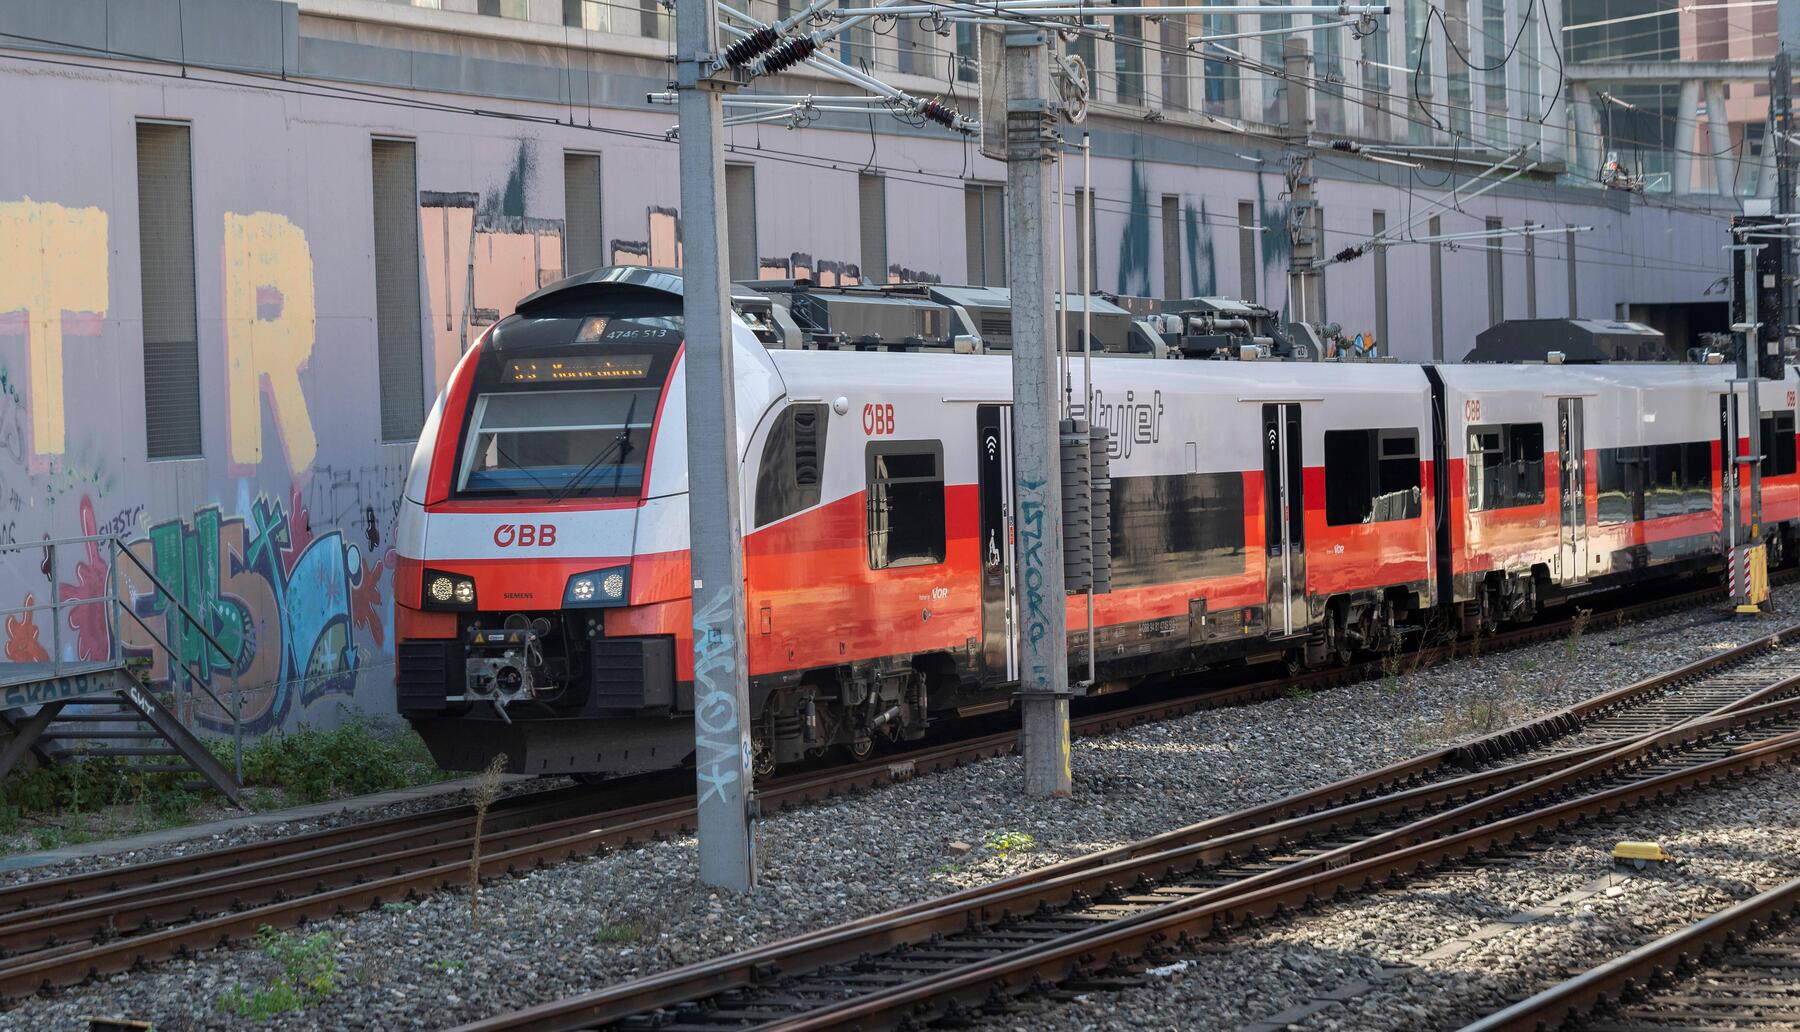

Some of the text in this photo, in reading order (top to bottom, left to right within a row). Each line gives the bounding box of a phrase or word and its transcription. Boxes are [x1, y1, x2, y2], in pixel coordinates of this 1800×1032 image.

[606, 329, 667, 339] 4746 513
[863, 403, 895, 436] ÖBB
[1465, 399, 1480, 421] ÖBB
[494, 524, 557, 547] ÖBB
[932, 586, 949, 600] VOR
